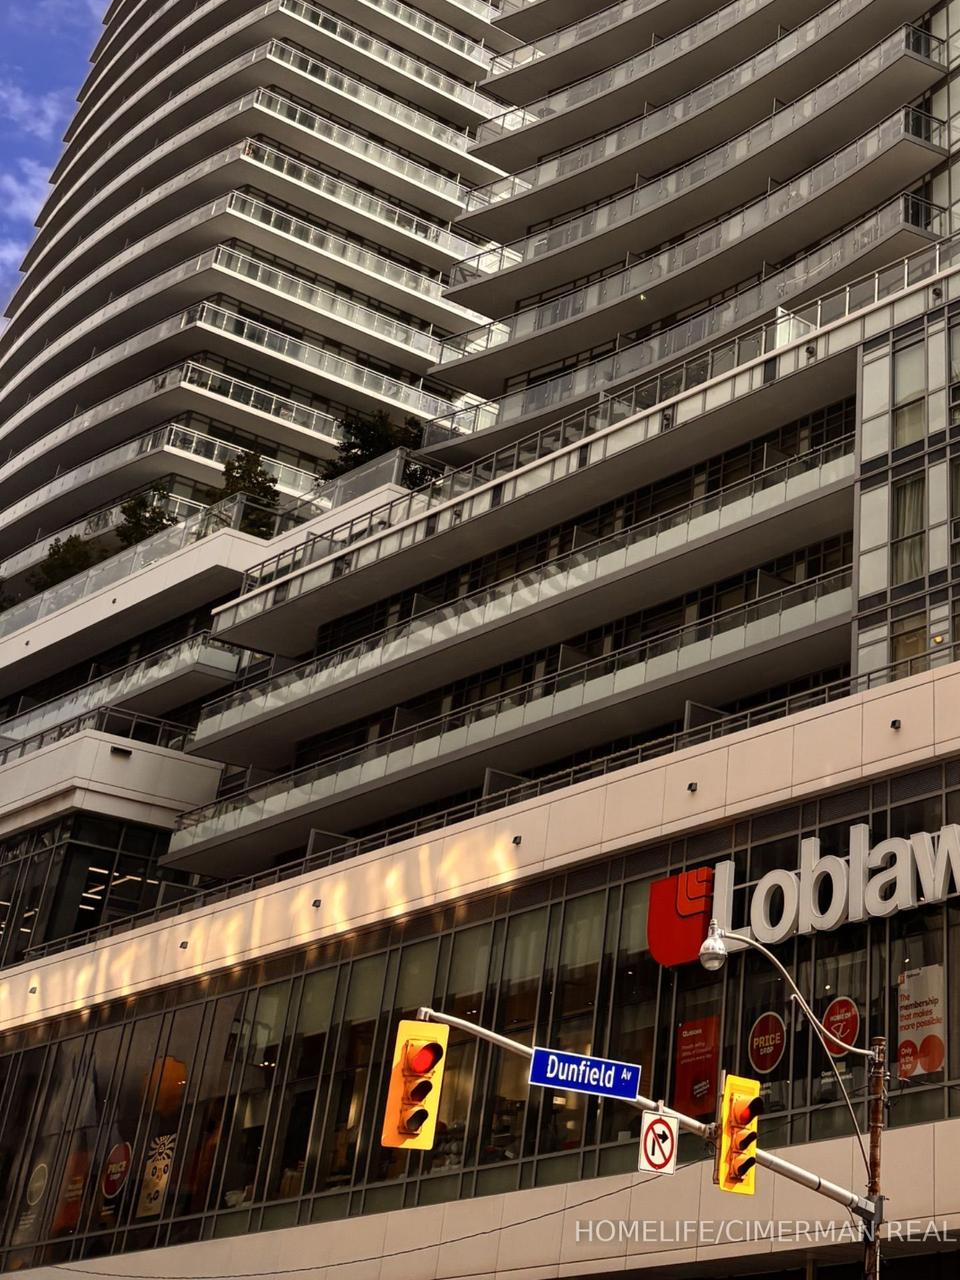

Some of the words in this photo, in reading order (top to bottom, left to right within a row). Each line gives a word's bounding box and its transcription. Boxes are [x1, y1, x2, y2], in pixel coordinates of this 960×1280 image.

[753, 1033, 781, 1049] PRICE
[546, 1055, 615, 1088] Dunfield
[621, 1068, 632, 1080] Av
